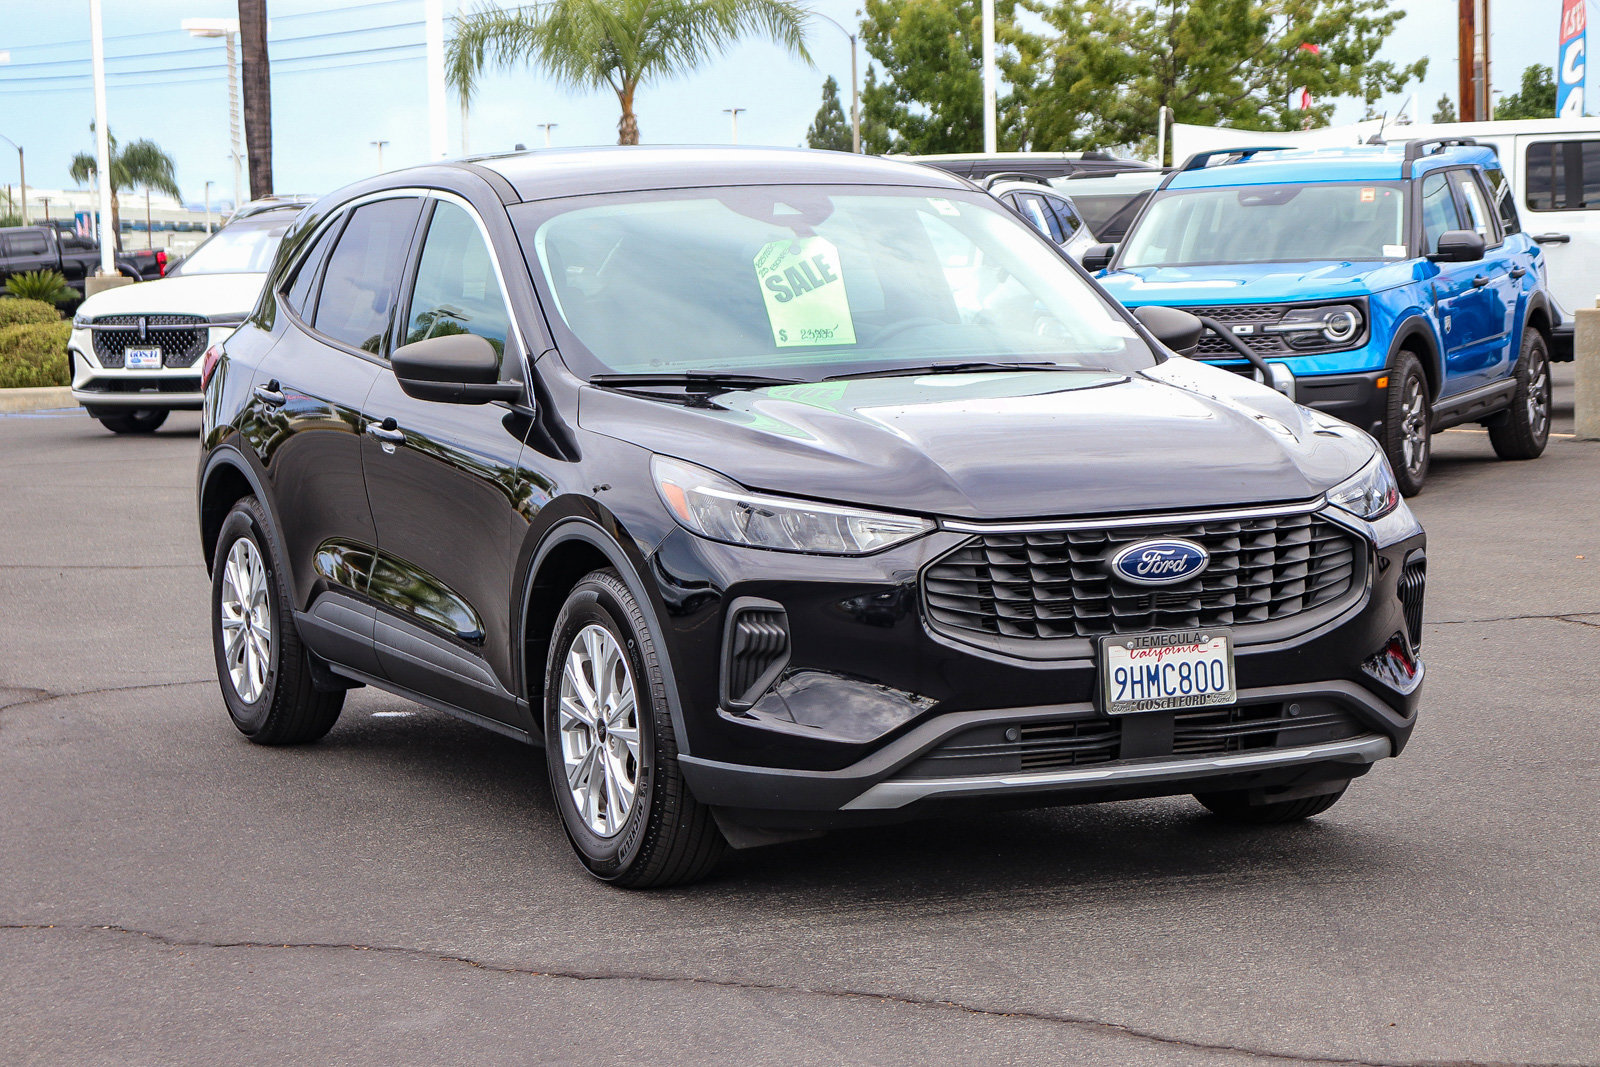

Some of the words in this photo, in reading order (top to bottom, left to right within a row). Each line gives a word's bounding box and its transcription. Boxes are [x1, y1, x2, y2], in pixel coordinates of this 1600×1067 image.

[764, 253, 839, 303] SALE
[1137, 549, 1189, 575] Ford
[1134, 632, 1201, 648] TEMECULA
[1114, 658, 1225, 701] 9HMC800
[1180, 693, 1207, 707] FORD
